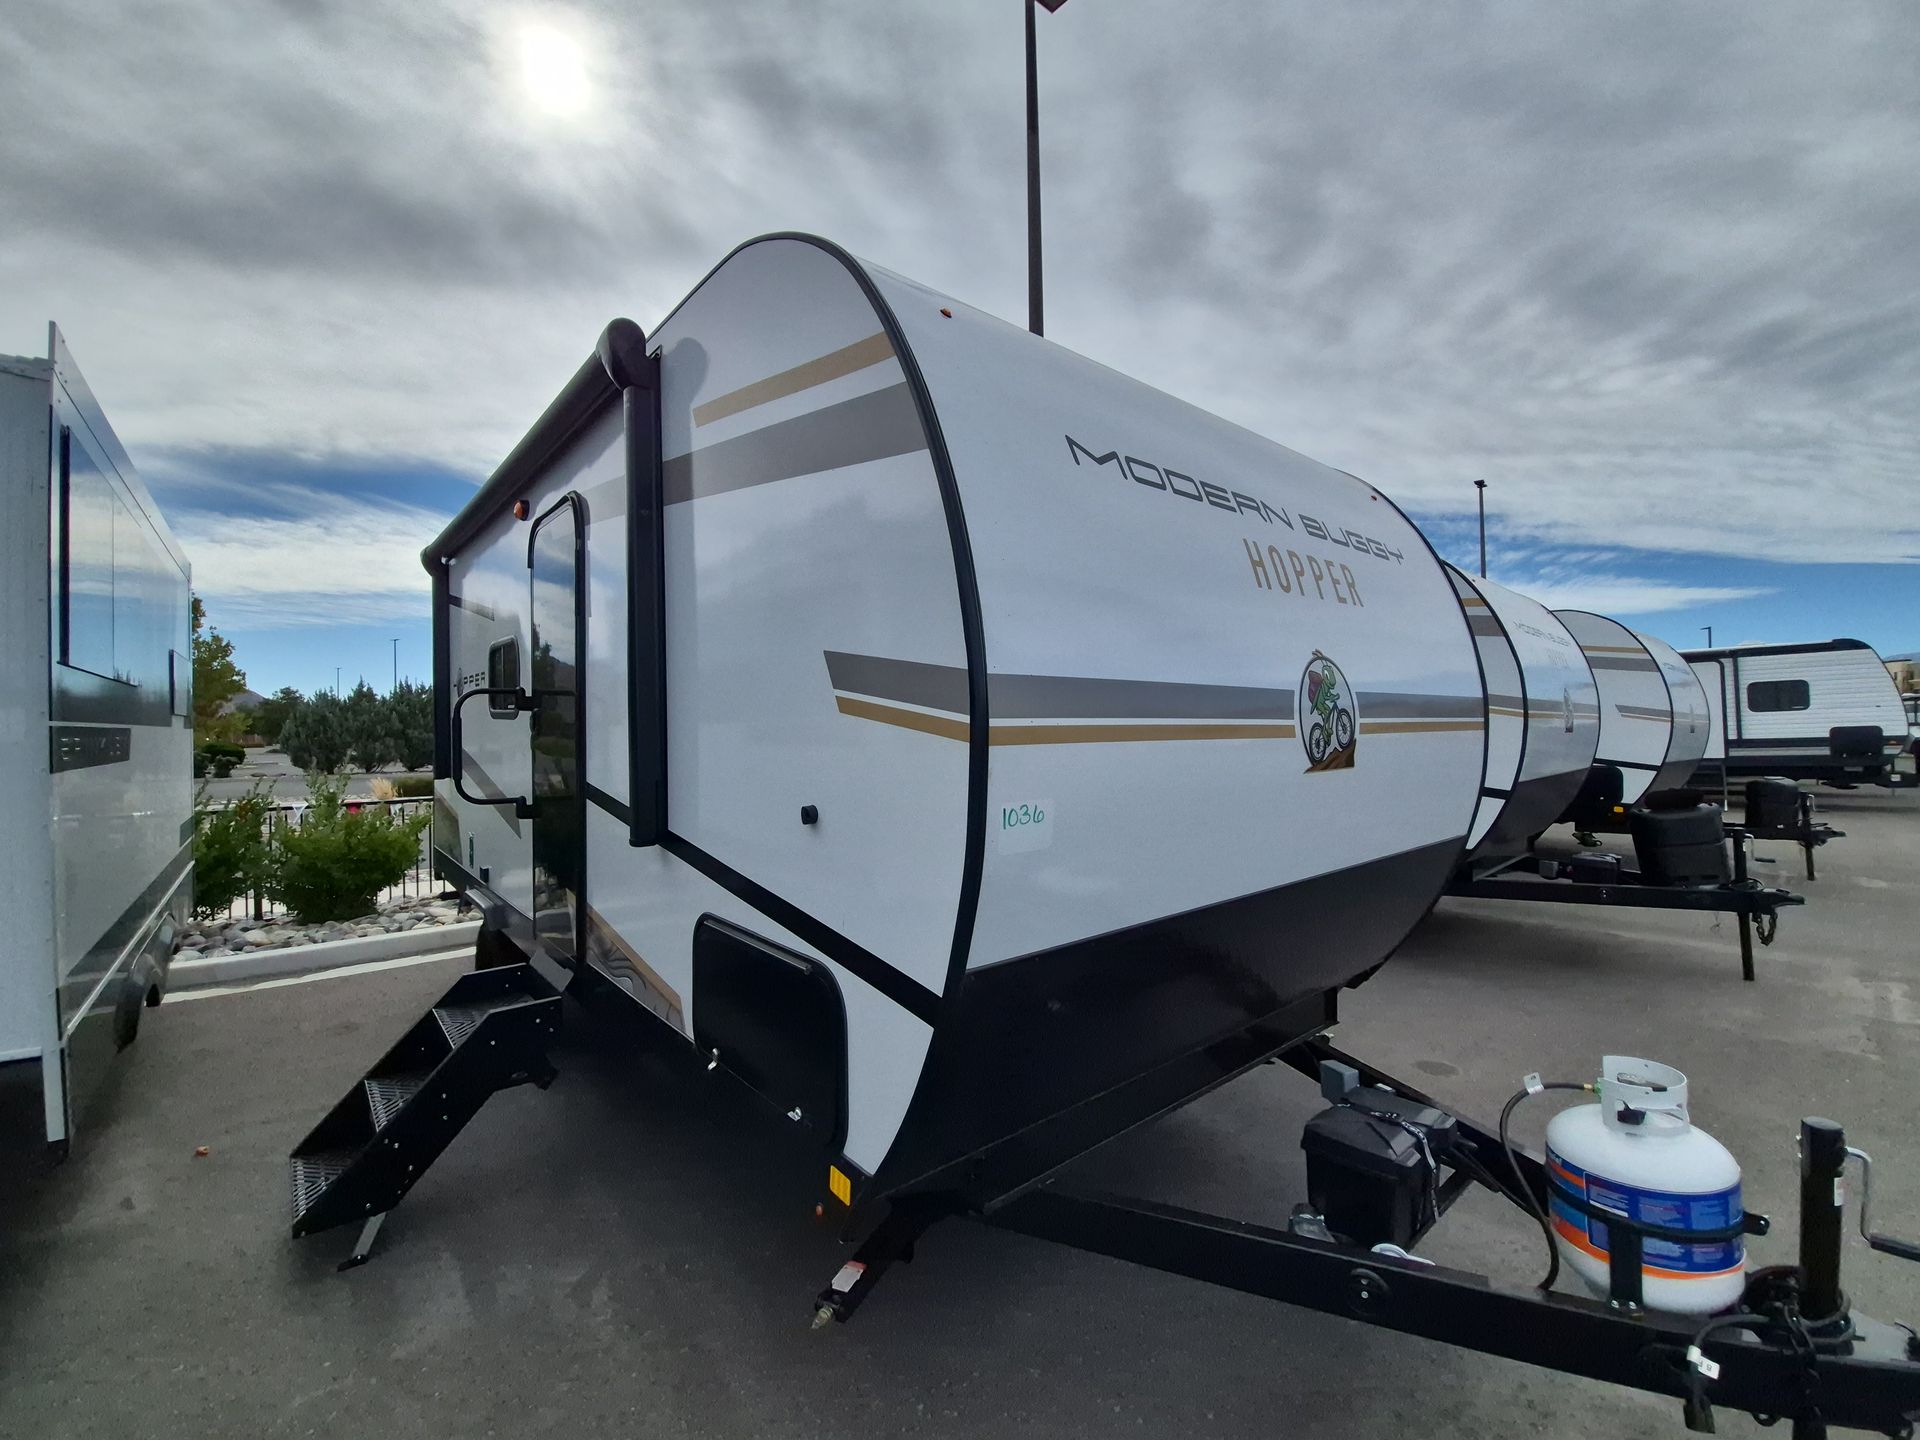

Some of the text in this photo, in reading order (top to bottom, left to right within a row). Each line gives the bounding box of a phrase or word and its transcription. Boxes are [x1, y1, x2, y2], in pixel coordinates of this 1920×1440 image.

[1065, 434, 1405, 565] MODERN BUGGY
[1243, 538, 1364, 608] HOPPER
[1003, 804, 1044, 830] 1036
